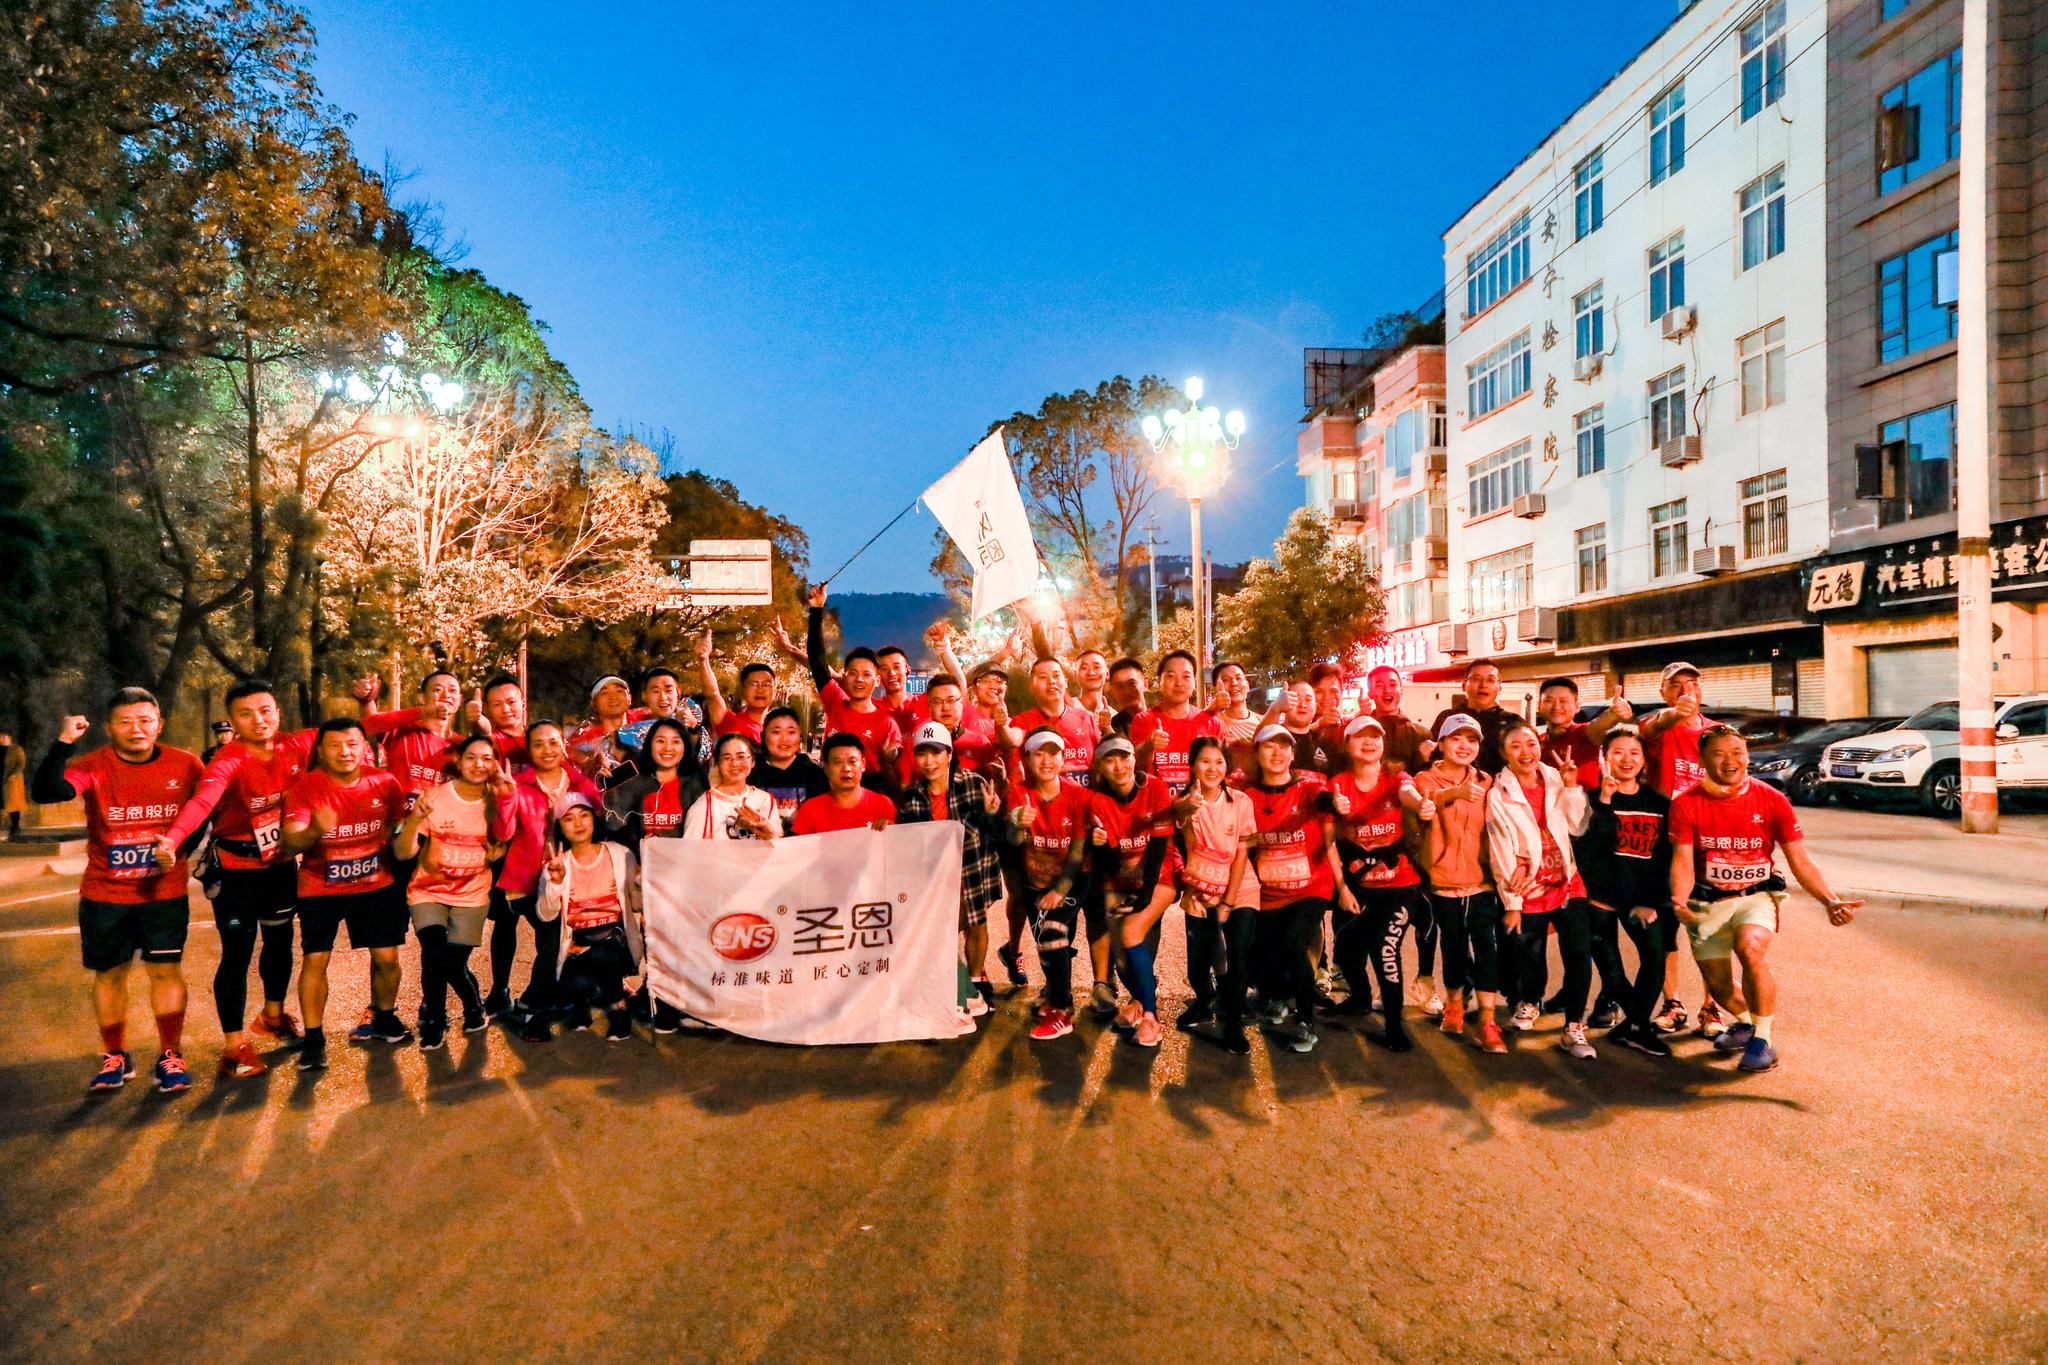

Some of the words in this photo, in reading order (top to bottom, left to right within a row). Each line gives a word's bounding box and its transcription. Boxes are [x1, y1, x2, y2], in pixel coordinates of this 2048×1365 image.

[108, 803, 179, 821] 圣恩股份
[1356, 823, 1396, 838] 恩股份
[1700, 836, 1764, 850] 圣恩股份
[328, 856, 379, 879] 30864
[1710, 867, 1766, 880] 10868
[711, 924, 776, 950] SNS
[792, 901, 894, 956] 圣恩
[1382, 924, 1403, 983] ADIDAS
[709, 969, 794, 987] 标准味道
[813, 957, 891, 981] 匠心定制
